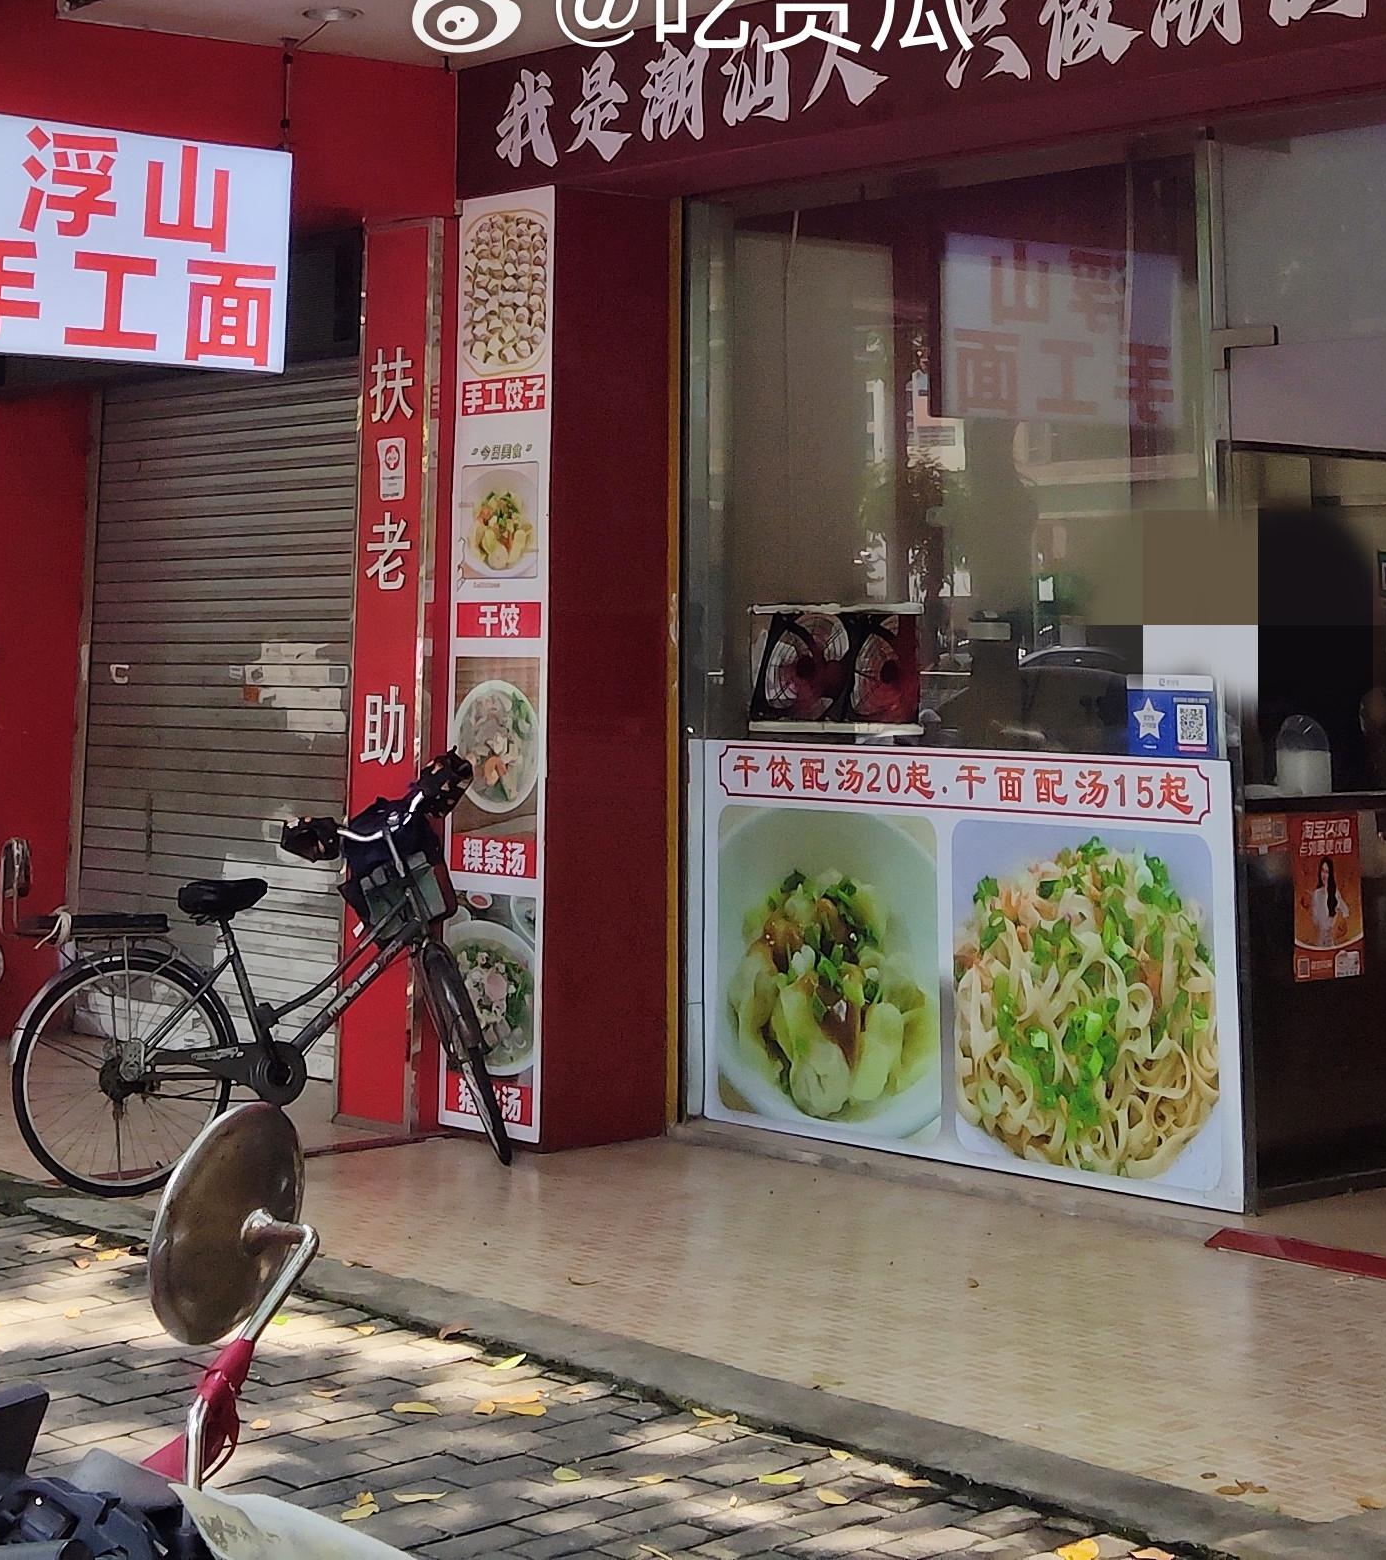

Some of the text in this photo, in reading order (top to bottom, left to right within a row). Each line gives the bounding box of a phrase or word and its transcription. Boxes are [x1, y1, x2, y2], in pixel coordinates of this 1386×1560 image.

[496, 12, 890, 168] 我是潮汕人
[19, 125, 230, 252] 浮山
[463, 376, 546, 414] 手工饺子
[357, 347, 414, 937] 扶老助
[479, 604, 520, 637] 干饺
[459, 1077, 522, 1122] 猪汤
